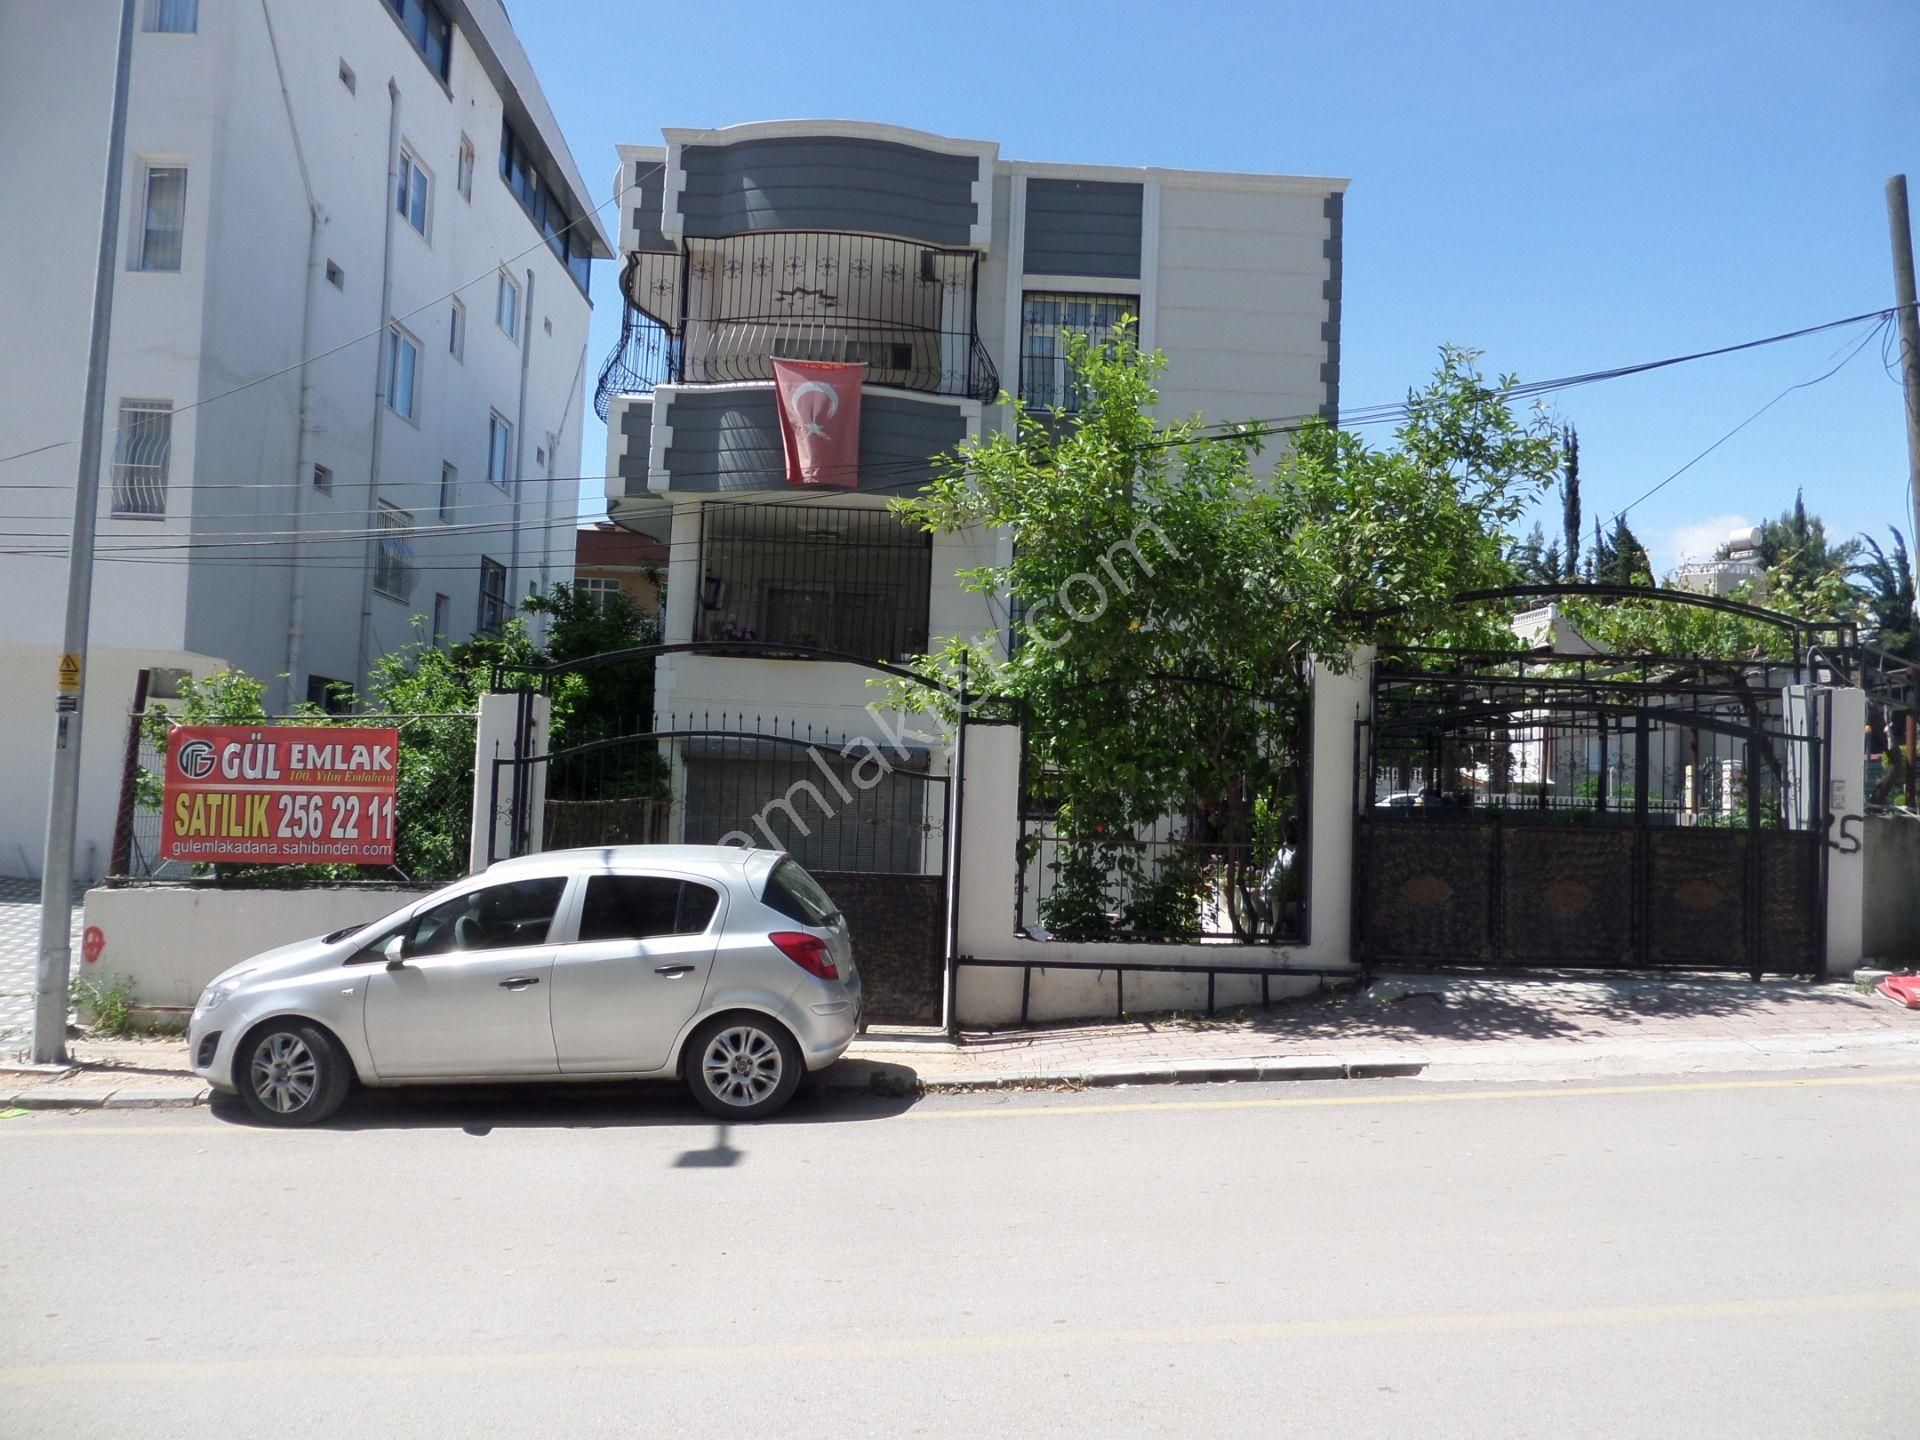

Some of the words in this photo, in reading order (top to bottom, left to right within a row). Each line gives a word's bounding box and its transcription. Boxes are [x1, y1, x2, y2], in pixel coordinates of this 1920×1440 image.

[221, 732, 281, 780] GÜL
[290, 743, 393, 771] EMLAK
[174, 792, 271, 838] SATILIK
[277, 794, 323, 839] 256
[330, 795, 360, 839] 22
[368, 795, 393, 840] 11
[172, 839, 392, 856] gulemlakadana.sahibinden.com
